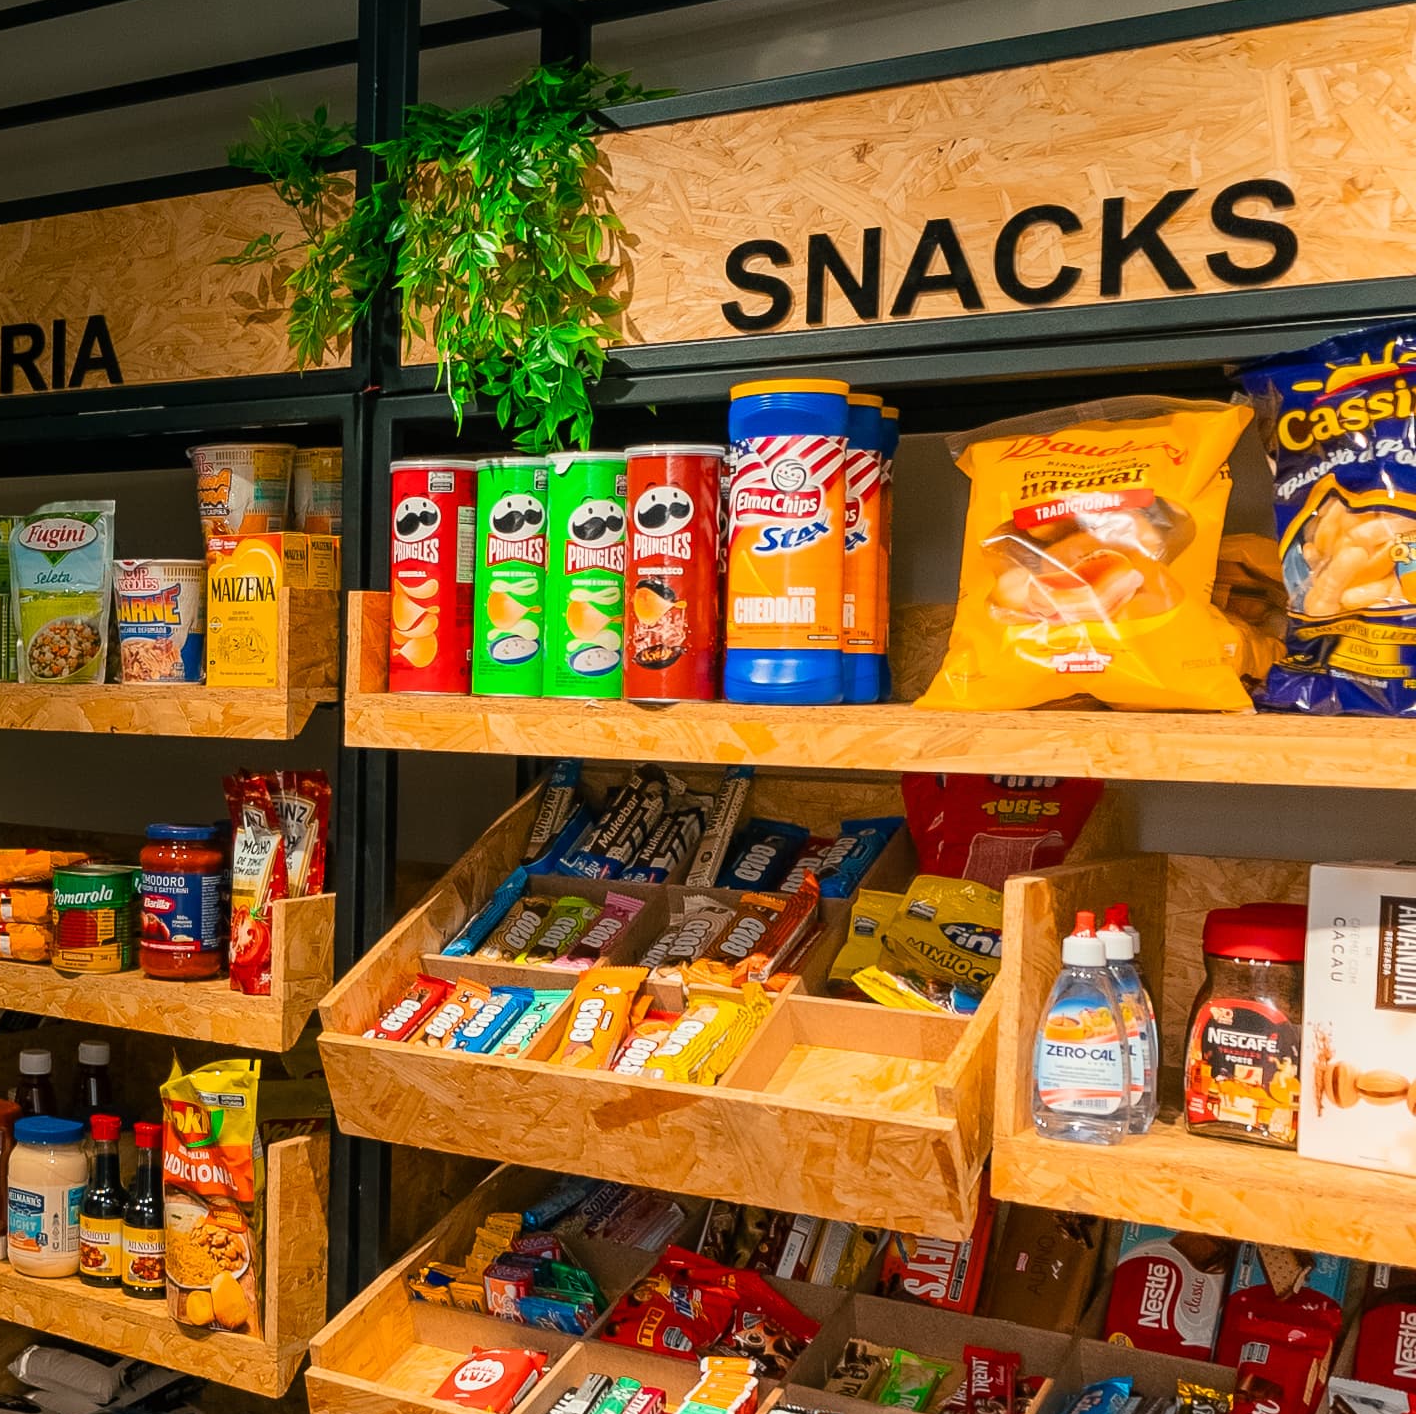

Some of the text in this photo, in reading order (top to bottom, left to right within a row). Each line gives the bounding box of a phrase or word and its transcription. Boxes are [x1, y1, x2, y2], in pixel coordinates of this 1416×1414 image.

[722, 178, 1298, 331] SNACKS
[1278, 379, 1416, 451] Cassi
[1020, 468, 1145, 500] natural
[1035, 494, 1121, 521] TRADICIONAL
[26, 524, 86, 548] Fugini
[634, 532, 691, 560] PRINGLES
[393, 538, 440, 564] PRINGLES
[488, 538, 544, 564] PRINGLES
[567, 545, 624, 571] PRINGLES
[211, 576, 276, 602] MAIZENA
[117, 583, 181, 625] ARNE
[735, 596, 816, 624] CHEDDAR
[981, 799, 1061, 816] TUBES
[598, 794, 639, 849] Mukebar
[639, 816, 675, 861] Mukebar
[53, 884, 114, 906] Pomarola
[1330, 916, 1346, 983] CACAU
[1045, 1043, 1116, 1061] ZERO-CAL
[1207, 1027, 1280, 1053] NESCAFÉ
[1225, 1054, 1254, 1065] FORTE
[1137, 1260, 1172, 1329] Nestlé
